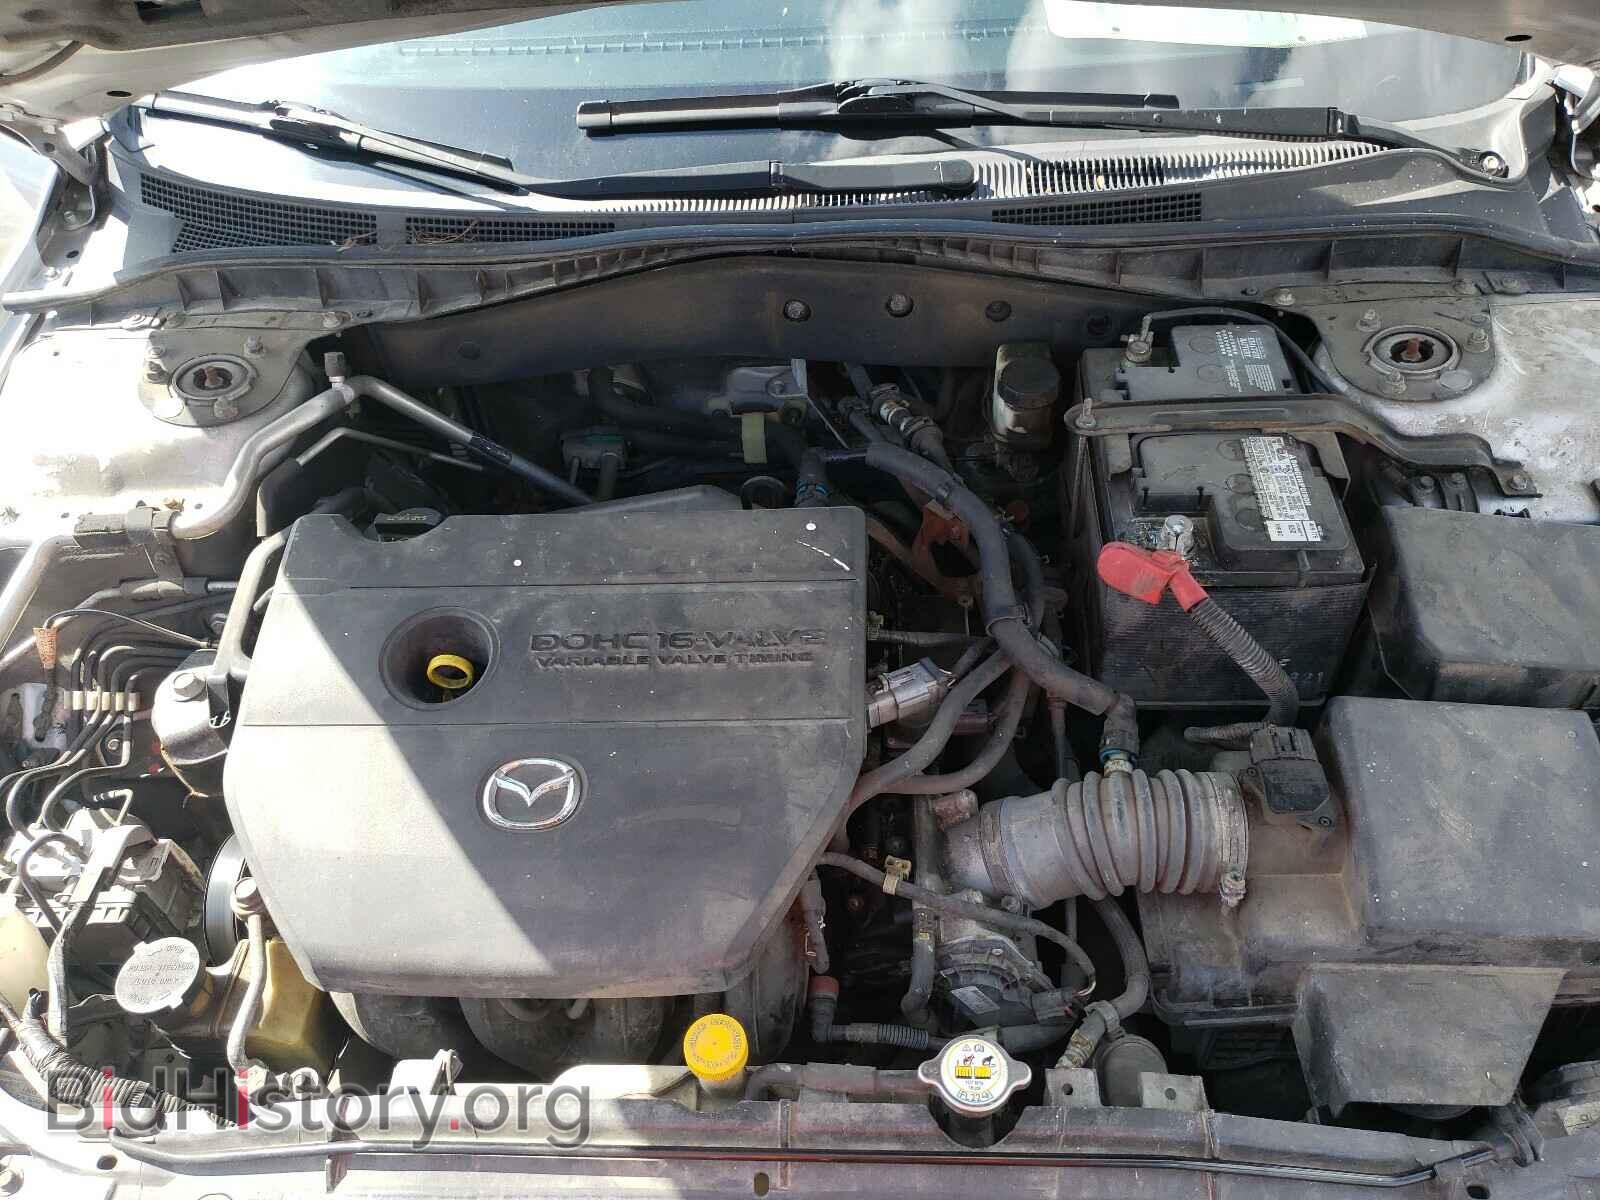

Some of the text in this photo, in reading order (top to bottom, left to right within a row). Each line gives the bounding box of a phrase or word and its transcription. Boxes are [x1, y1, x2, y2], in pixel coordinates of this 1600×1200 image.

[531, 630, 825, 650] DOHC 16-VALVE
[535, 651, 815, 668] VARIABLE VALVE TIMING
